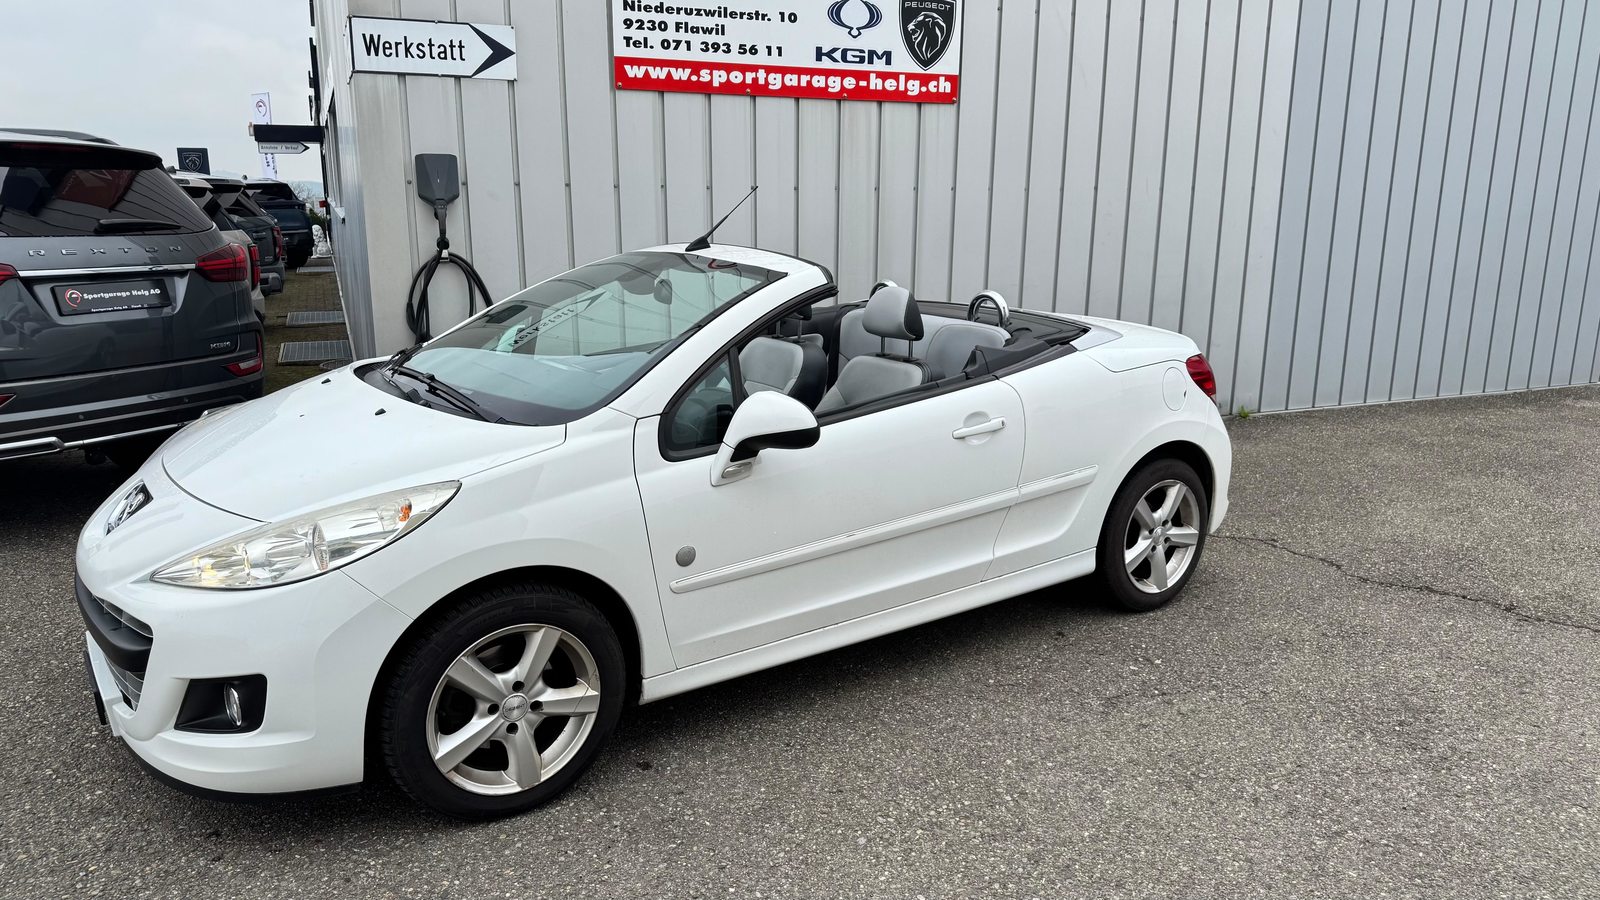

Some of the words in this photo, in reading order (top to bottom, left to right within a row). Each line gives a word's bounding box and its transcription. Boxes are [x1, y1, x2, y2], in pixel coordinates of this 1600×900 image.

[622, 0, 772, 22] Niederuzwilerstr.
[778, 11, 798, 23] 10
[904, 1, 951, 11] PEUGEOT
[622, 18, 669, 32] 9230
[674, 21, 726, 36] Flawil
[361, 33, 466, 61] Werkstatt
[623, 36, 655, 49] Tel.
[660, 39, 692, 51] 071
[700, 41, 732, 54] 393
[737, 44, 759, 56] 56
[766, 45, 783, 57] 11
[815, 46, 893, 66] KGM
[623, 64, 952, 96] www.sportgarage-helg.ch
[27, 245, 182, 257] REXTON
[82, 290, 131, 300] Sportgarage
